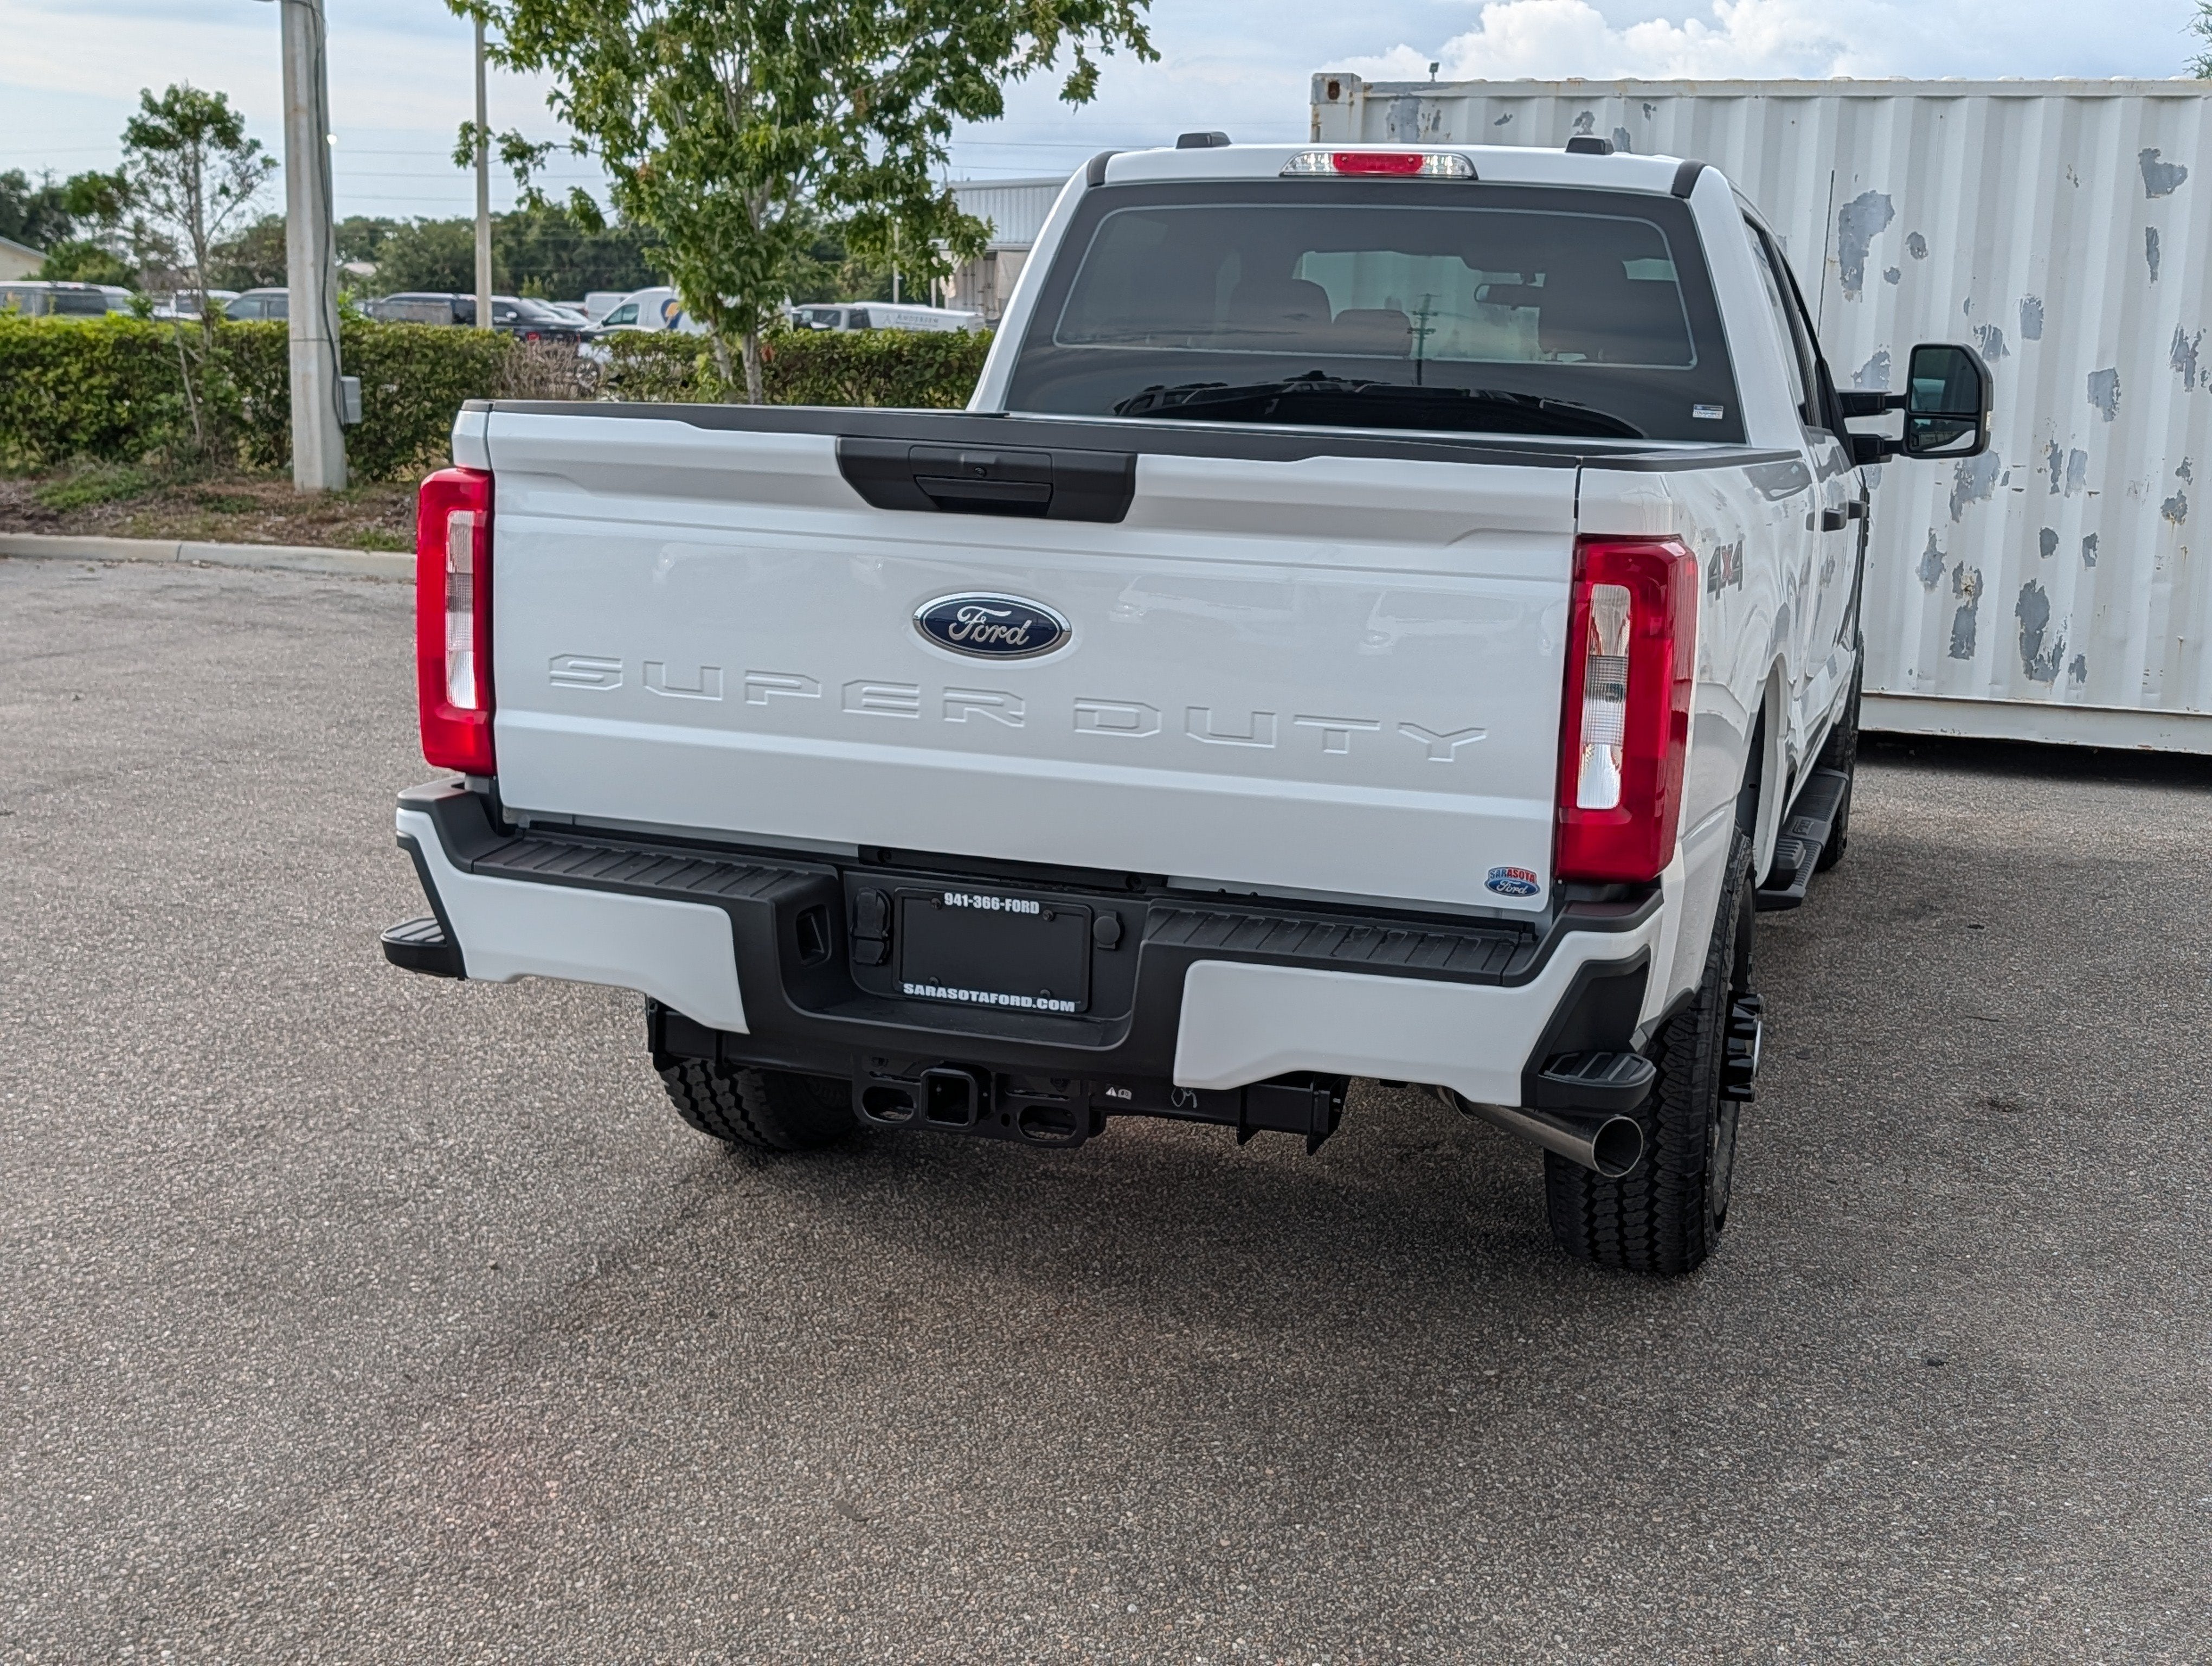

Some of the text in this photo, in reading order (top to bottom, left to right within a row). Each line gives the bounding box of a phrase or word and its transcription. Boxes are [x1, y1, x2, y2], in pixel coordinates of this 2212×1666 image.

[948, 605, 1032, 646] Ford
[549, 653, 1488, 762] SUPER DUTY
[1490, 869, 1535, 882] SARASOTA
[1496, 880, 1529, 894] Ford
[944, 892, 1040, 914] 941-366-FORD
[903, 983, 1075, 1013] SARASOTAFORD.COM
